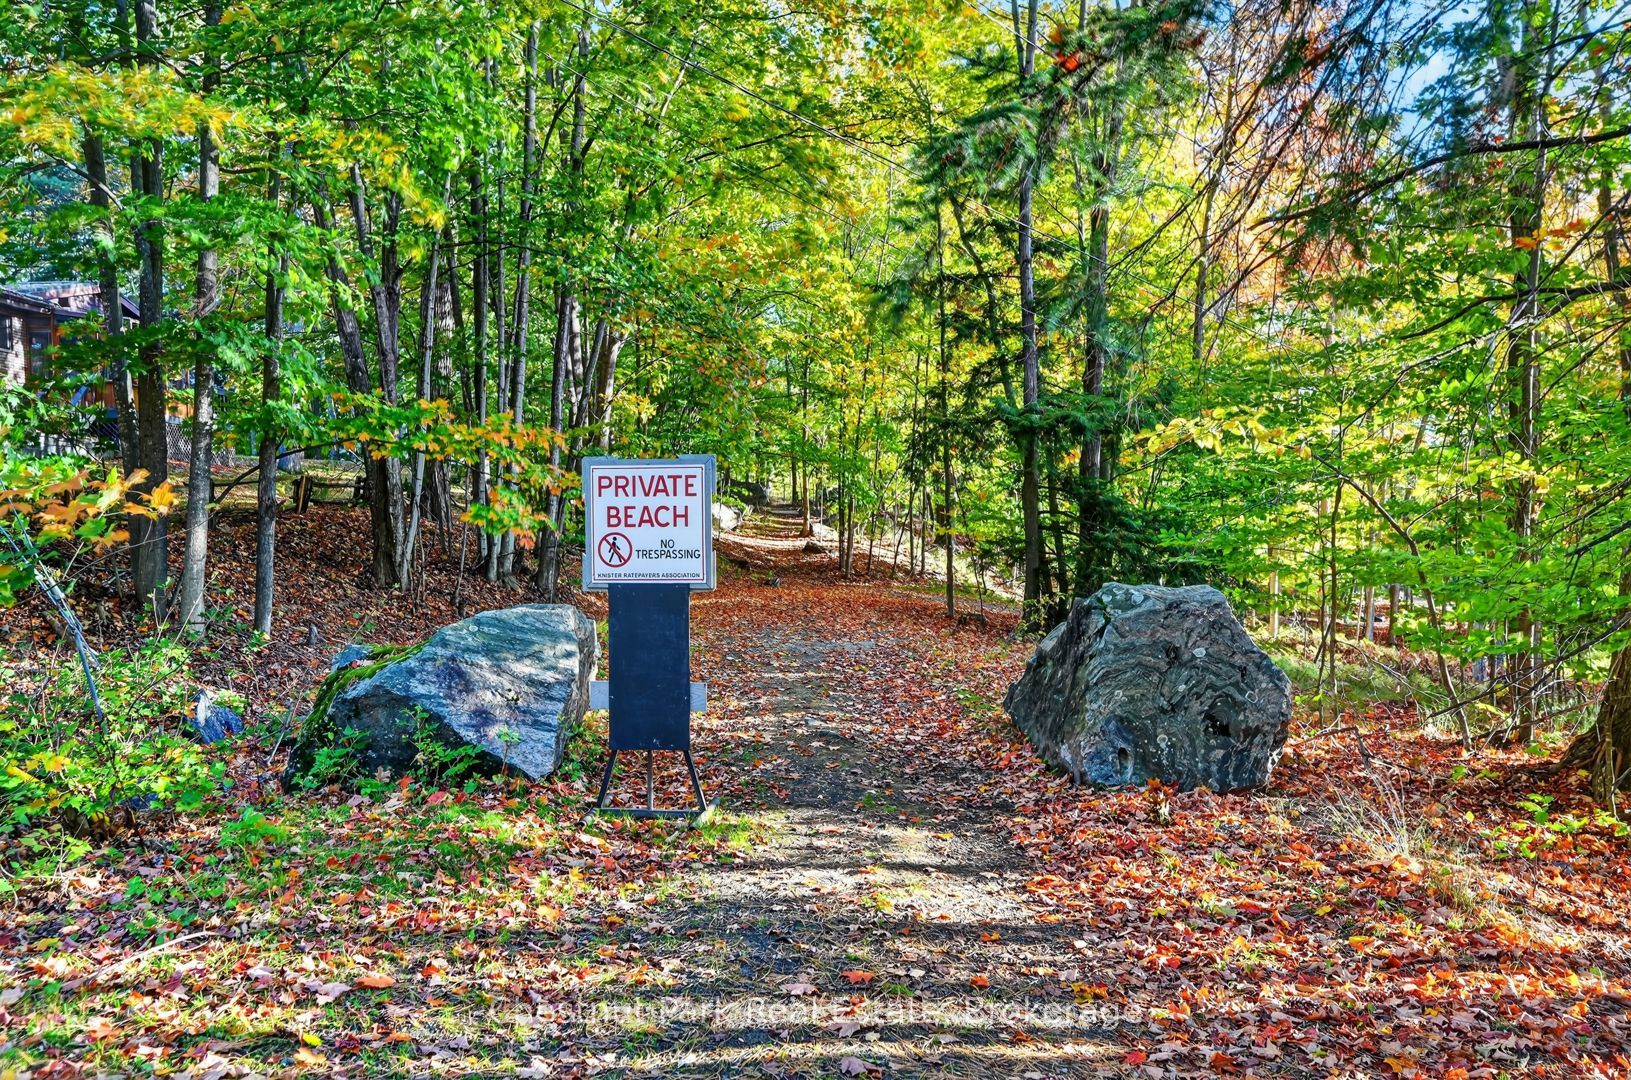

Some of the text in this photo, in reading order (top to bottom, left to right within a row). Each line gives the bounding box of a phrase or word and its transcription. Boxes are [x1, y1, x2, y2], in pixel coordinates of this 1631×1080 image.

[598, 475, 697, 497] PRIVATE
[607, 506, 688, 528] BEACH
[660, 539, 674, 549] NO
[636, 549, 700, 559] TRESPASSING
